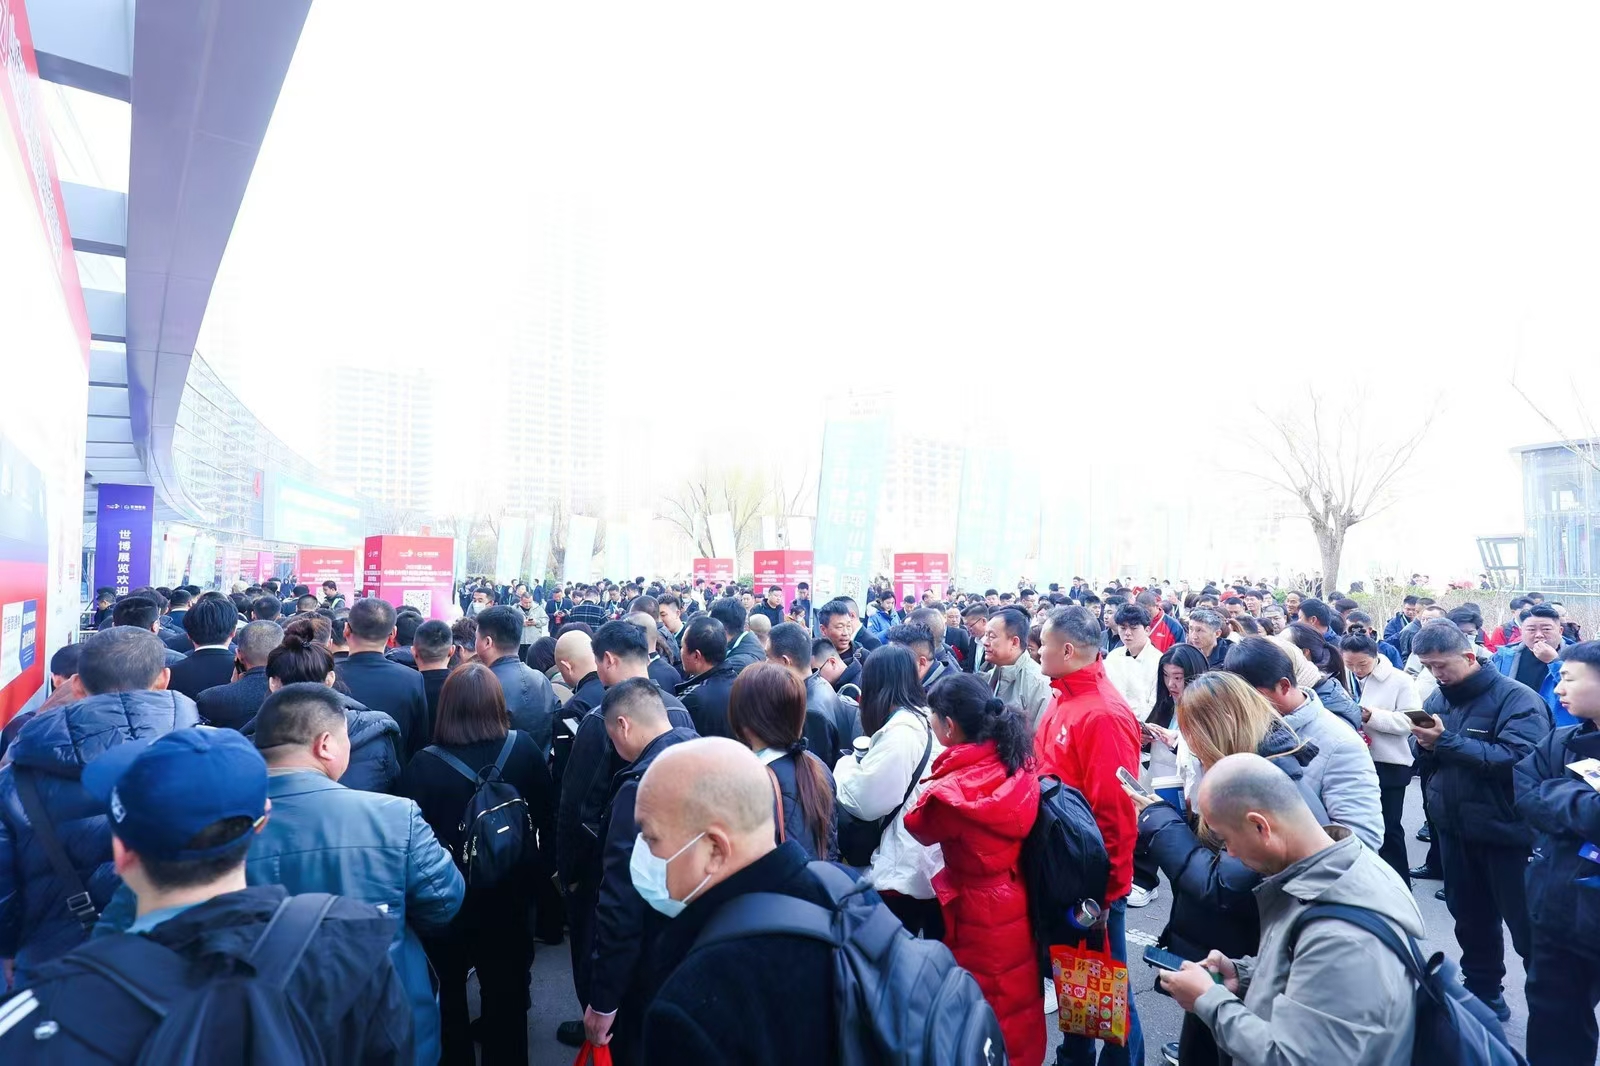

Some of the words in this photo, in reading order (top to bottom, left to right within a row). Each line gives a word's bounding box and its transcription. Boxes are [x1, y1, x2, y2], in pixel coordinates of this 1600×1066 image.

[116, 529, 132, 597] 世博展览欢迎
